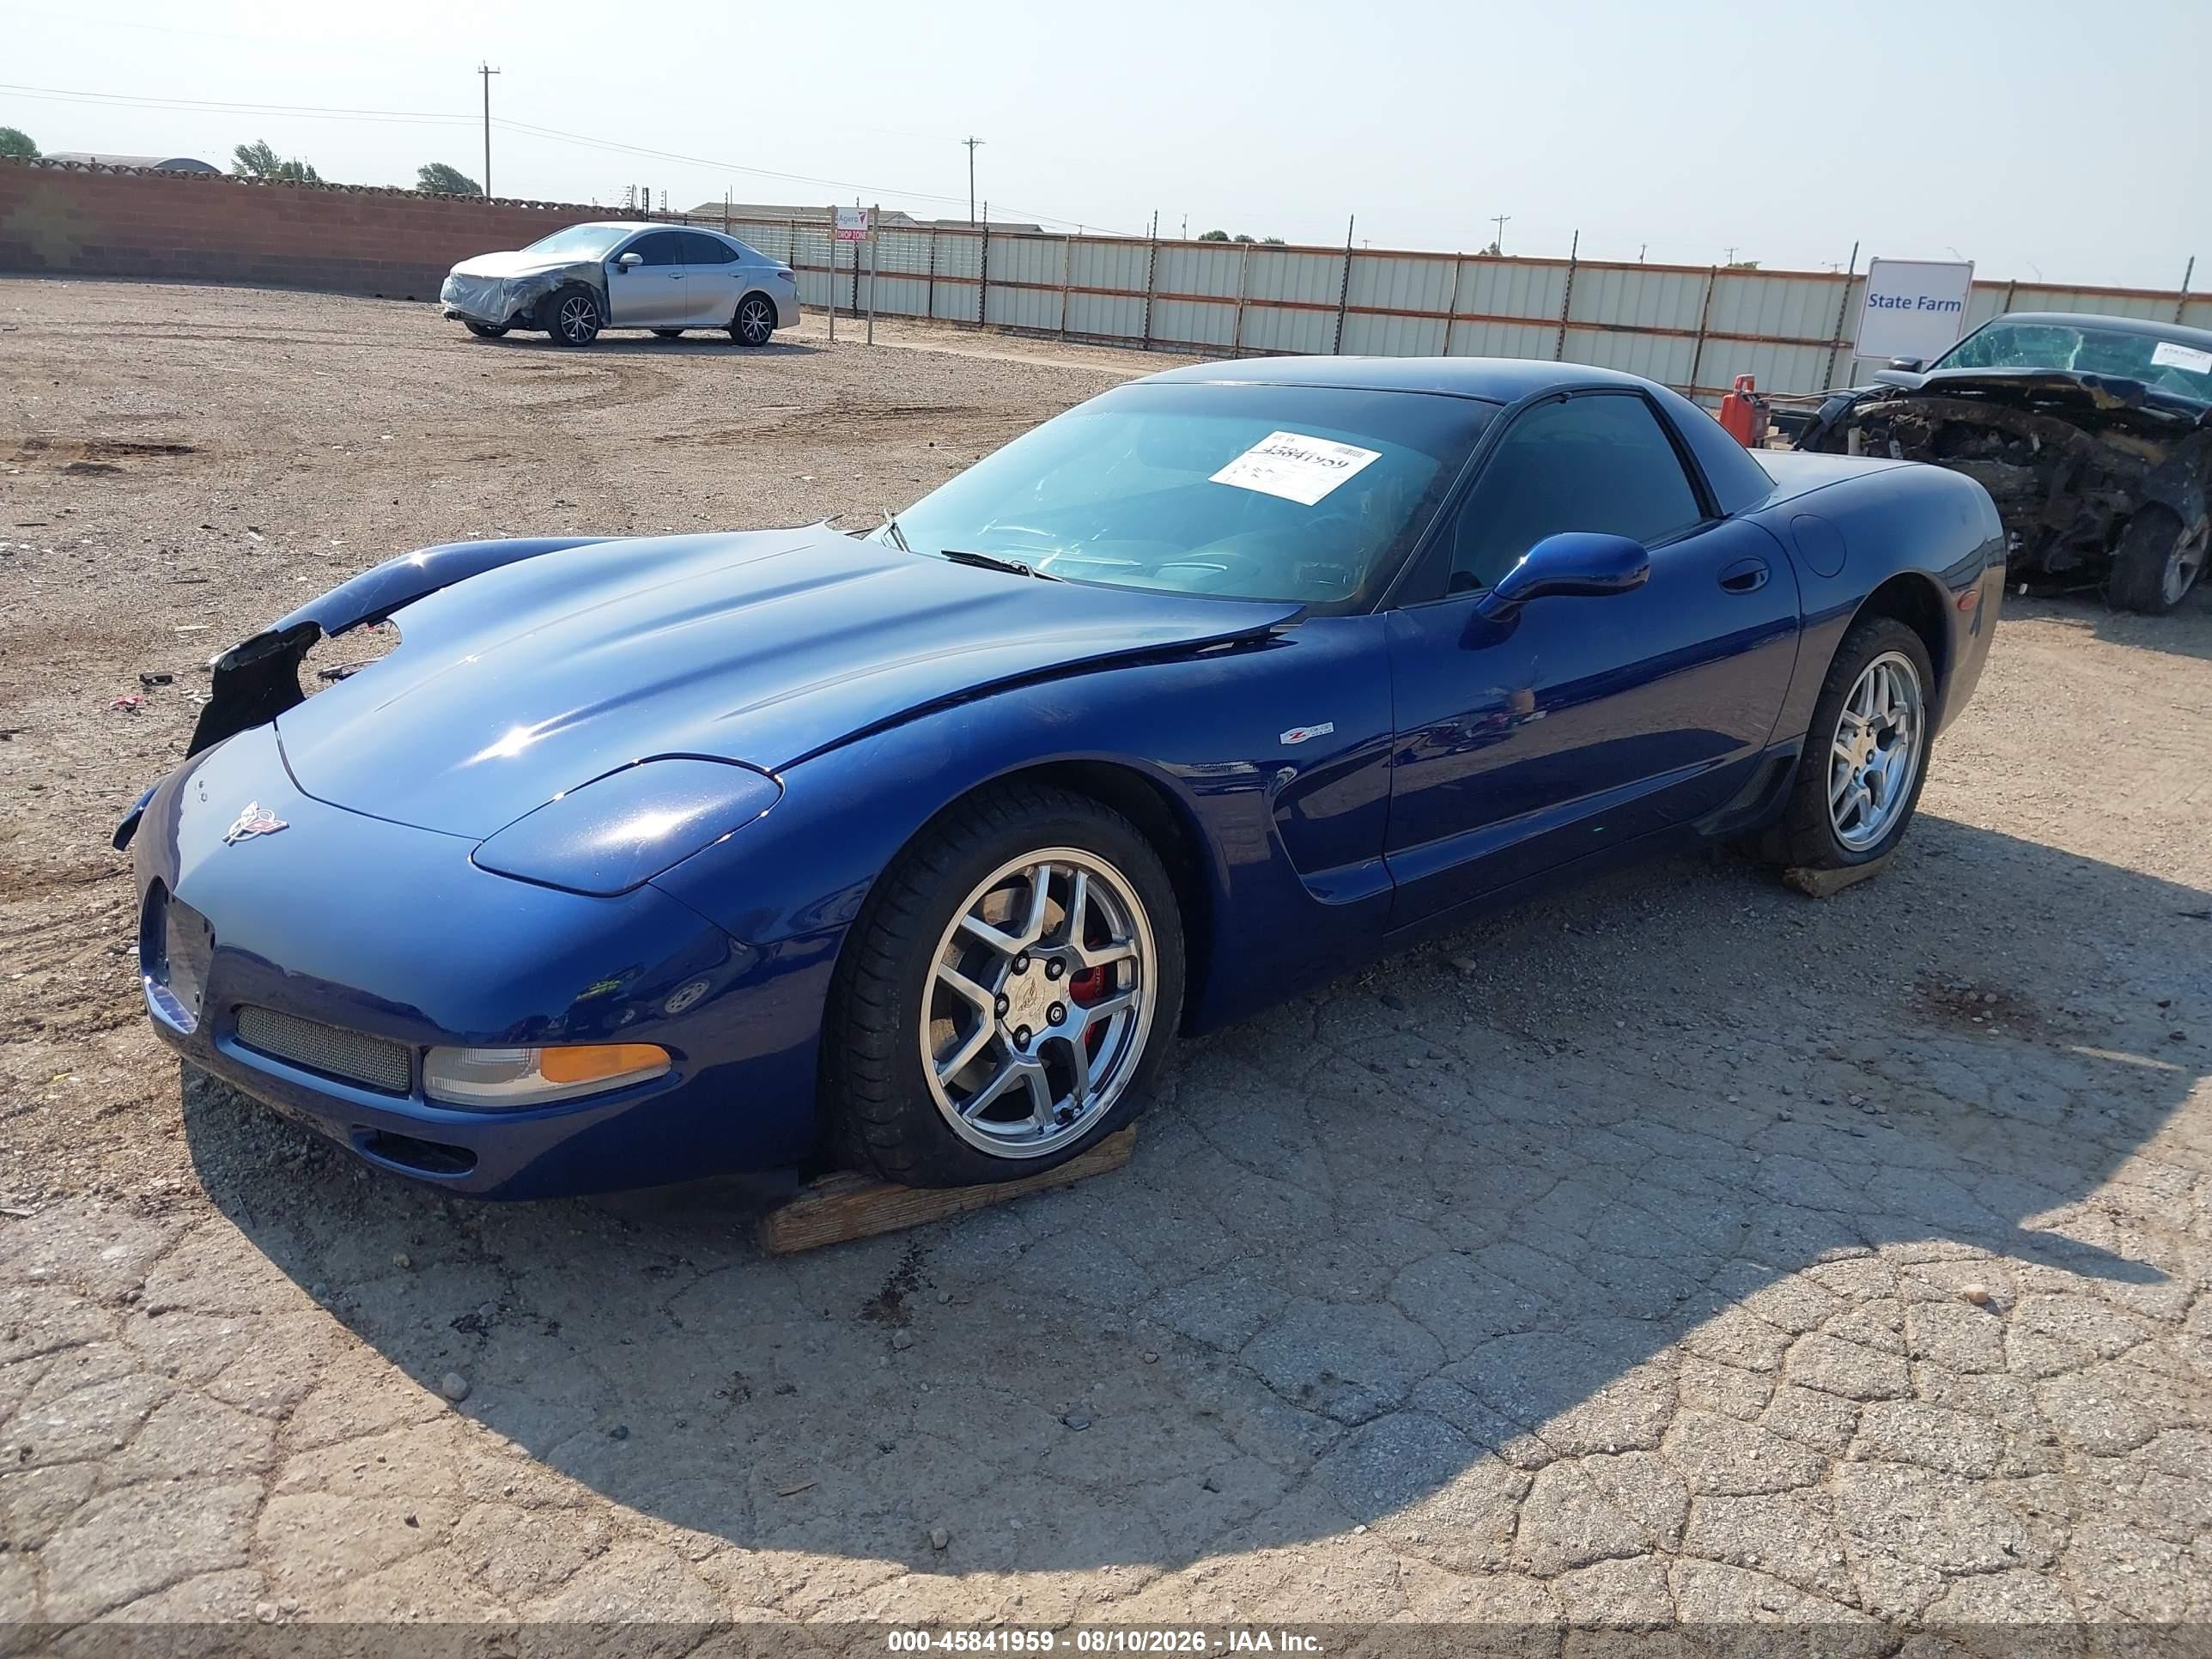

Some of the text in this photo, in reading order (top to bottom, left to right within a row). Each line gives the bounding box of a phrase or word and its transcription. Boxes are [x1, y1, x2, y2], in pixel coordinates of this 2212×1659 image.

[838, 214, 859, 224] Agero
[838, 230, 866, 240] DROP ZONE
[1868, 294, 1961, 312] State Farm
